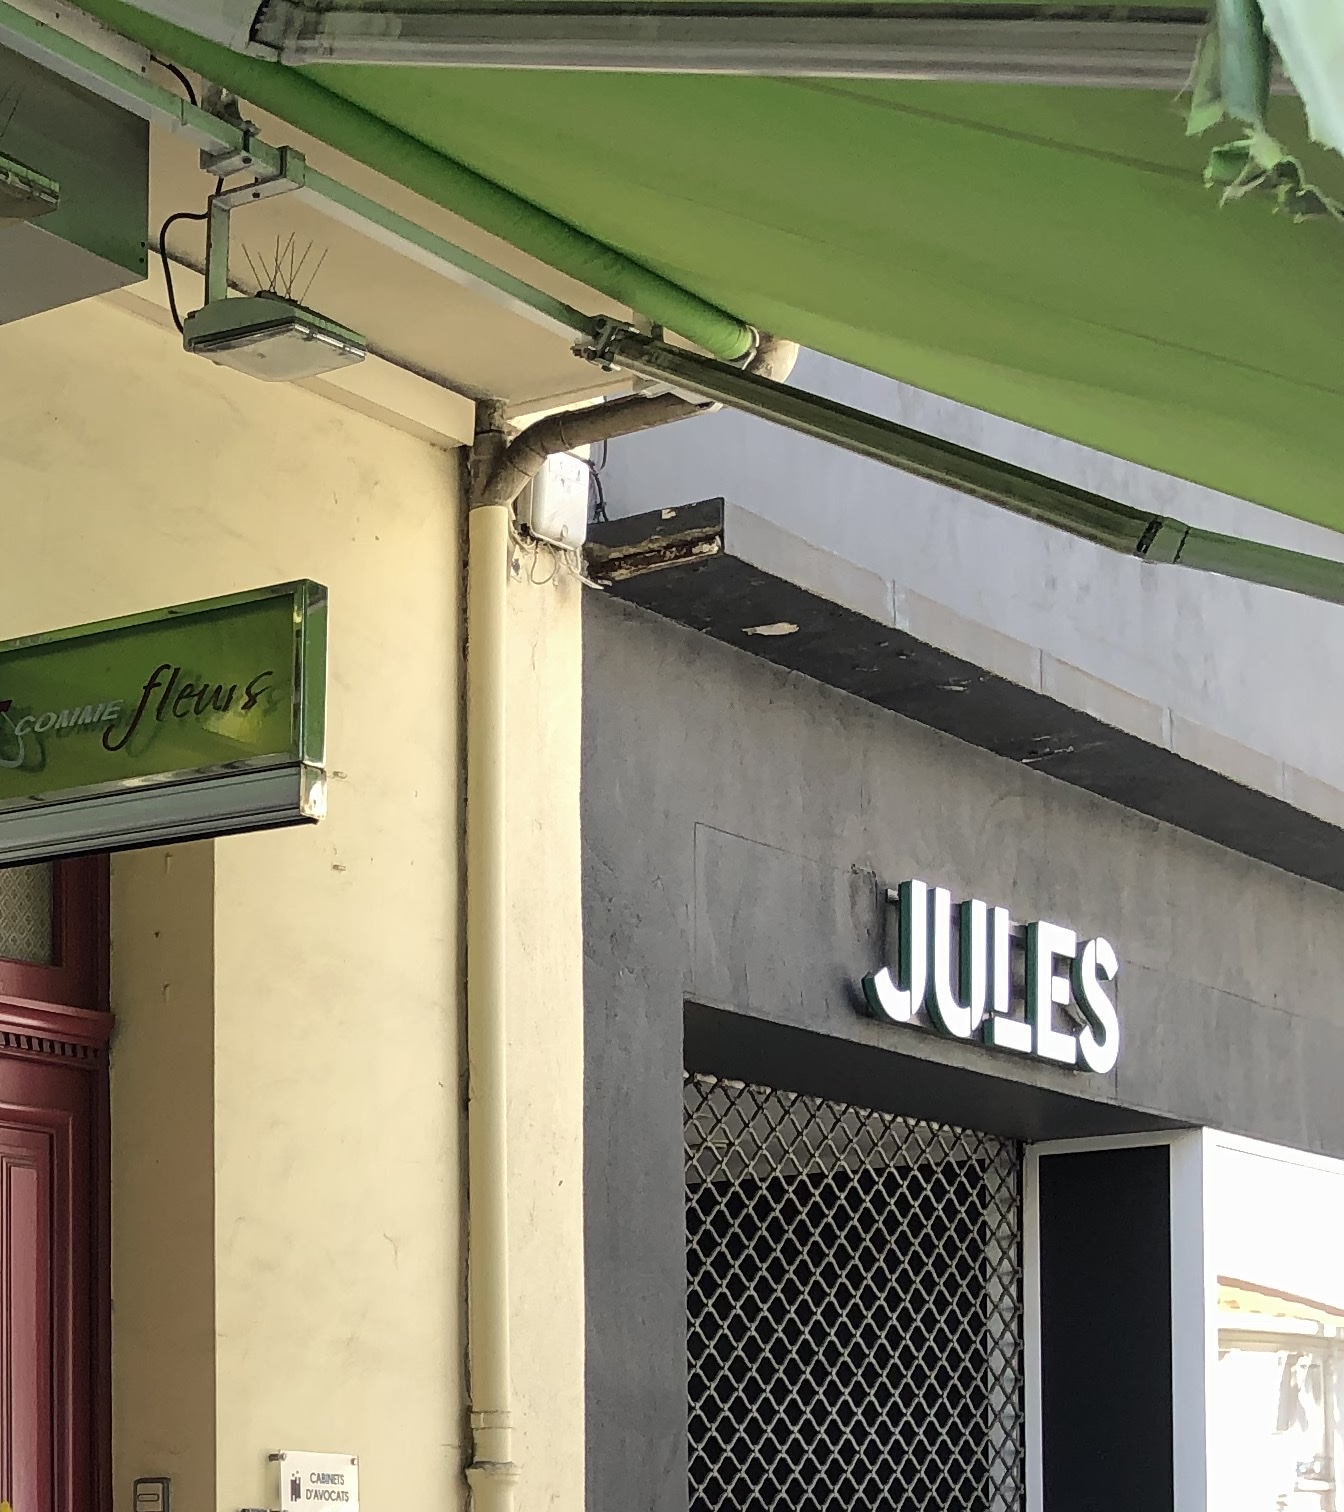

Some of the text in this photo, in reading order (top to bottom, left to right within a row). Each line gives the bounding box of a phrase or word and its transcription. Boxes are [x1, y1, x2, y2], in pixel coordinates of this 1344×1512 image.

[15, 699, 126, 737] COMME
[102, 663, 275, 752] fleurs
[862, 878, 1120, 1074] JULES
[305, 1489, 350, 1503] D'AVOCATS
[309, 1472, 345, 1486] CABINETS
